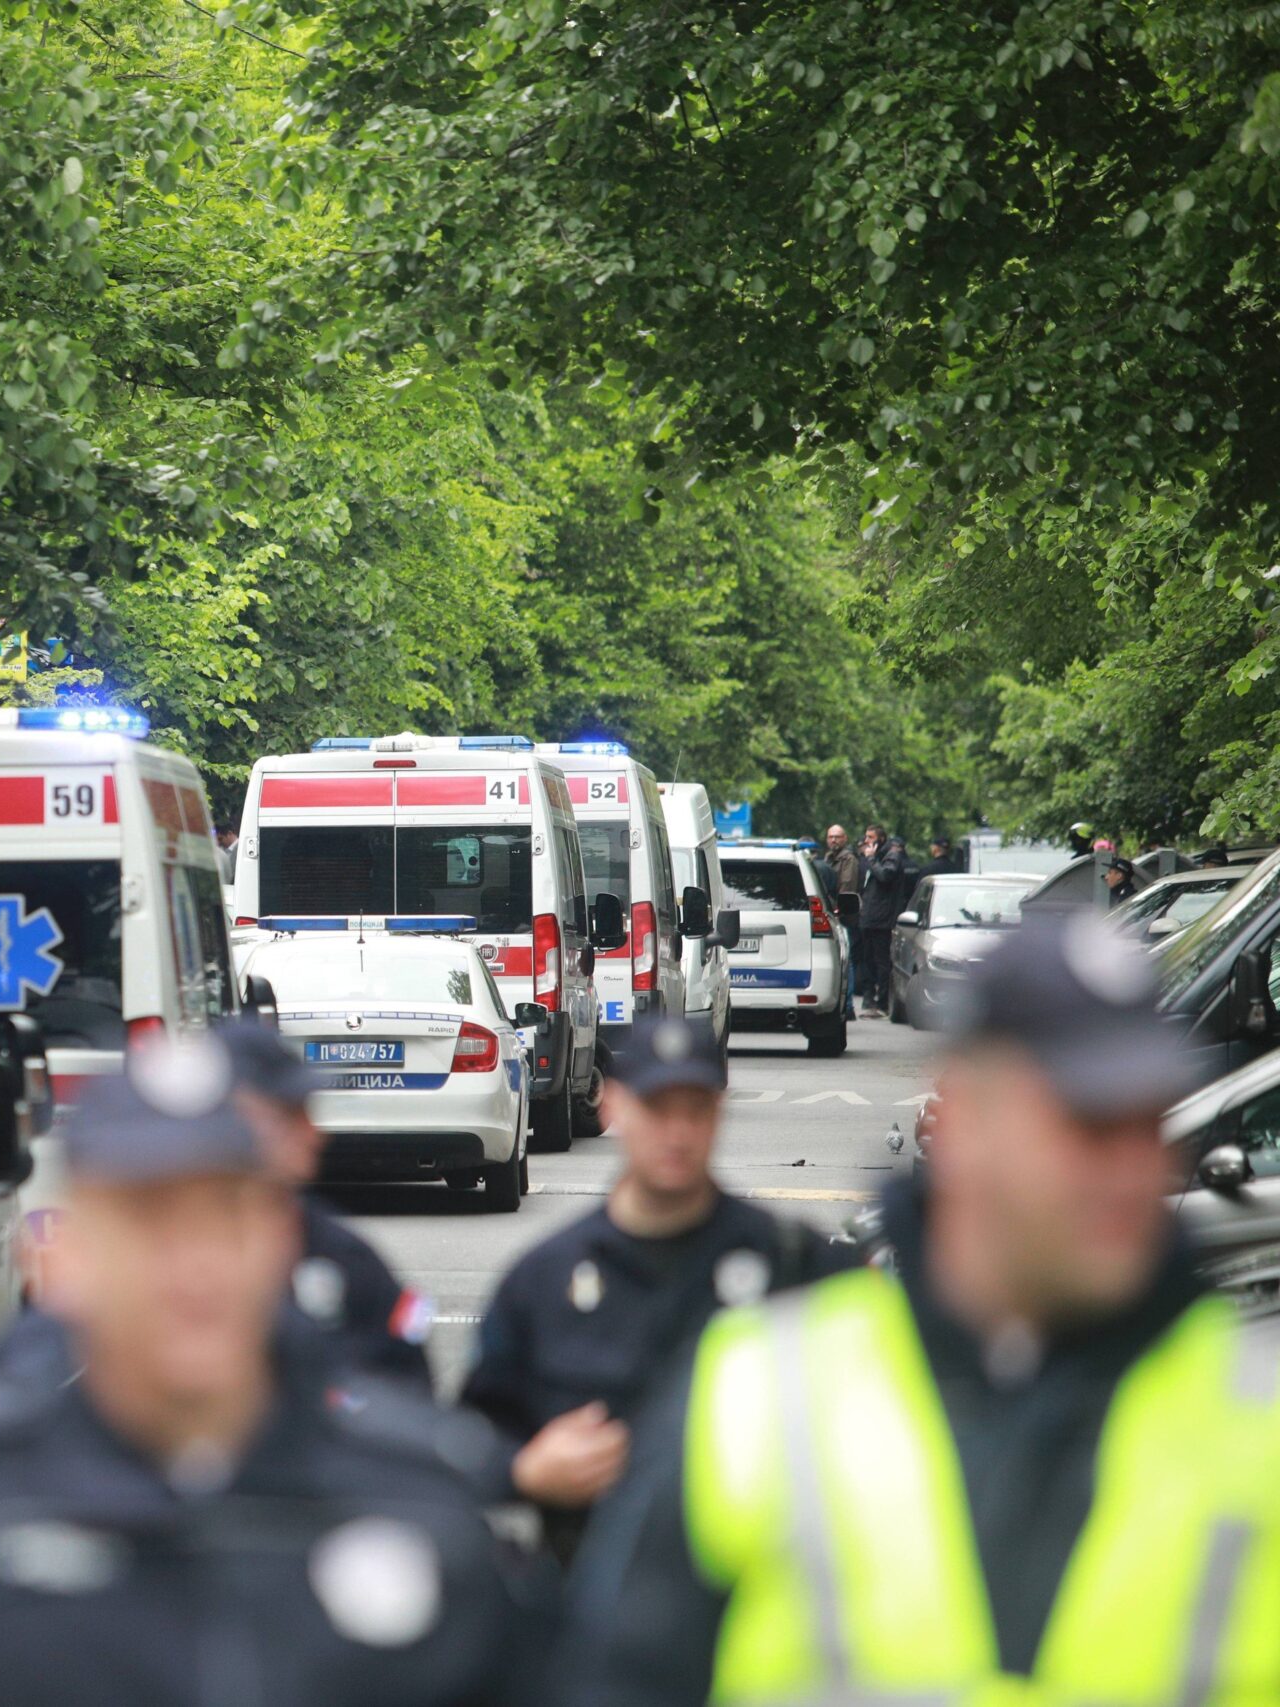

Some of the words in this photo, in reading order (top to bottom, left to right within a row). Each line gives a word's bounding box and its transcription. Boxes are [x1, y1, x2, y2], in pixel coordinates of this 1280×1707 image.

[489, 781, 516, 799] 41
[590, 782, 616, 799] 52
[53, 784, 94, 817] 59
[428, 1026, 455, 1034] RAPID
